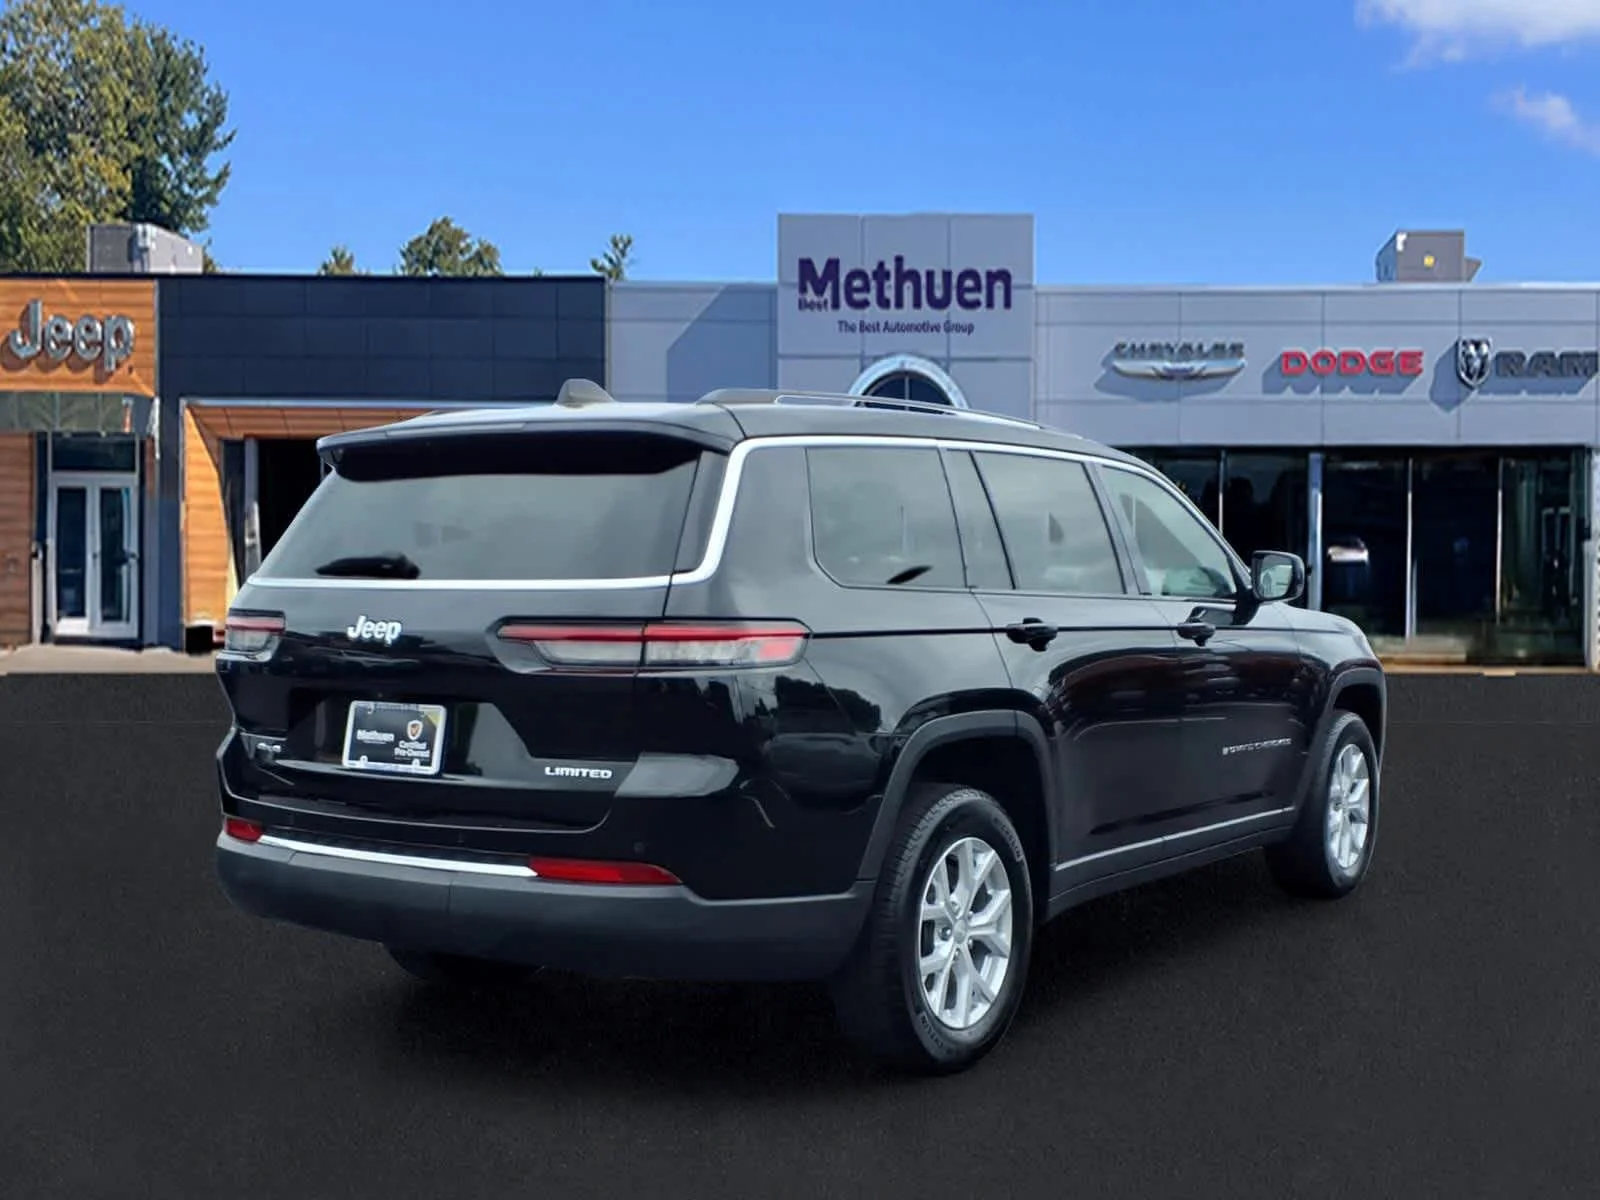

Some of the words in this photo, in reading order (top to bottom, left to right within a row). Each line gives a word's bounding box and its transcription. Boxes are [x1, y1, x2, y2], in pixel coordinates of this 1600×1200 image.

[798, 255, 1012, 310] Methuen
[798, 298, 829, 311] Best
[9, 299, 135, 372] Jeep
[838, 320, 857, 333] The
[859, 320, 881, 333] Best
[883, 320, 941, 333] Automotive
[944, 320, 975, 335] Group
[1281, 351, 1424, 375] DODGE
[1495, 351, 1599, 377] RAM
[347, 615, 402, 645] Jeep
[545, 766, 612, 779] LIMITED
